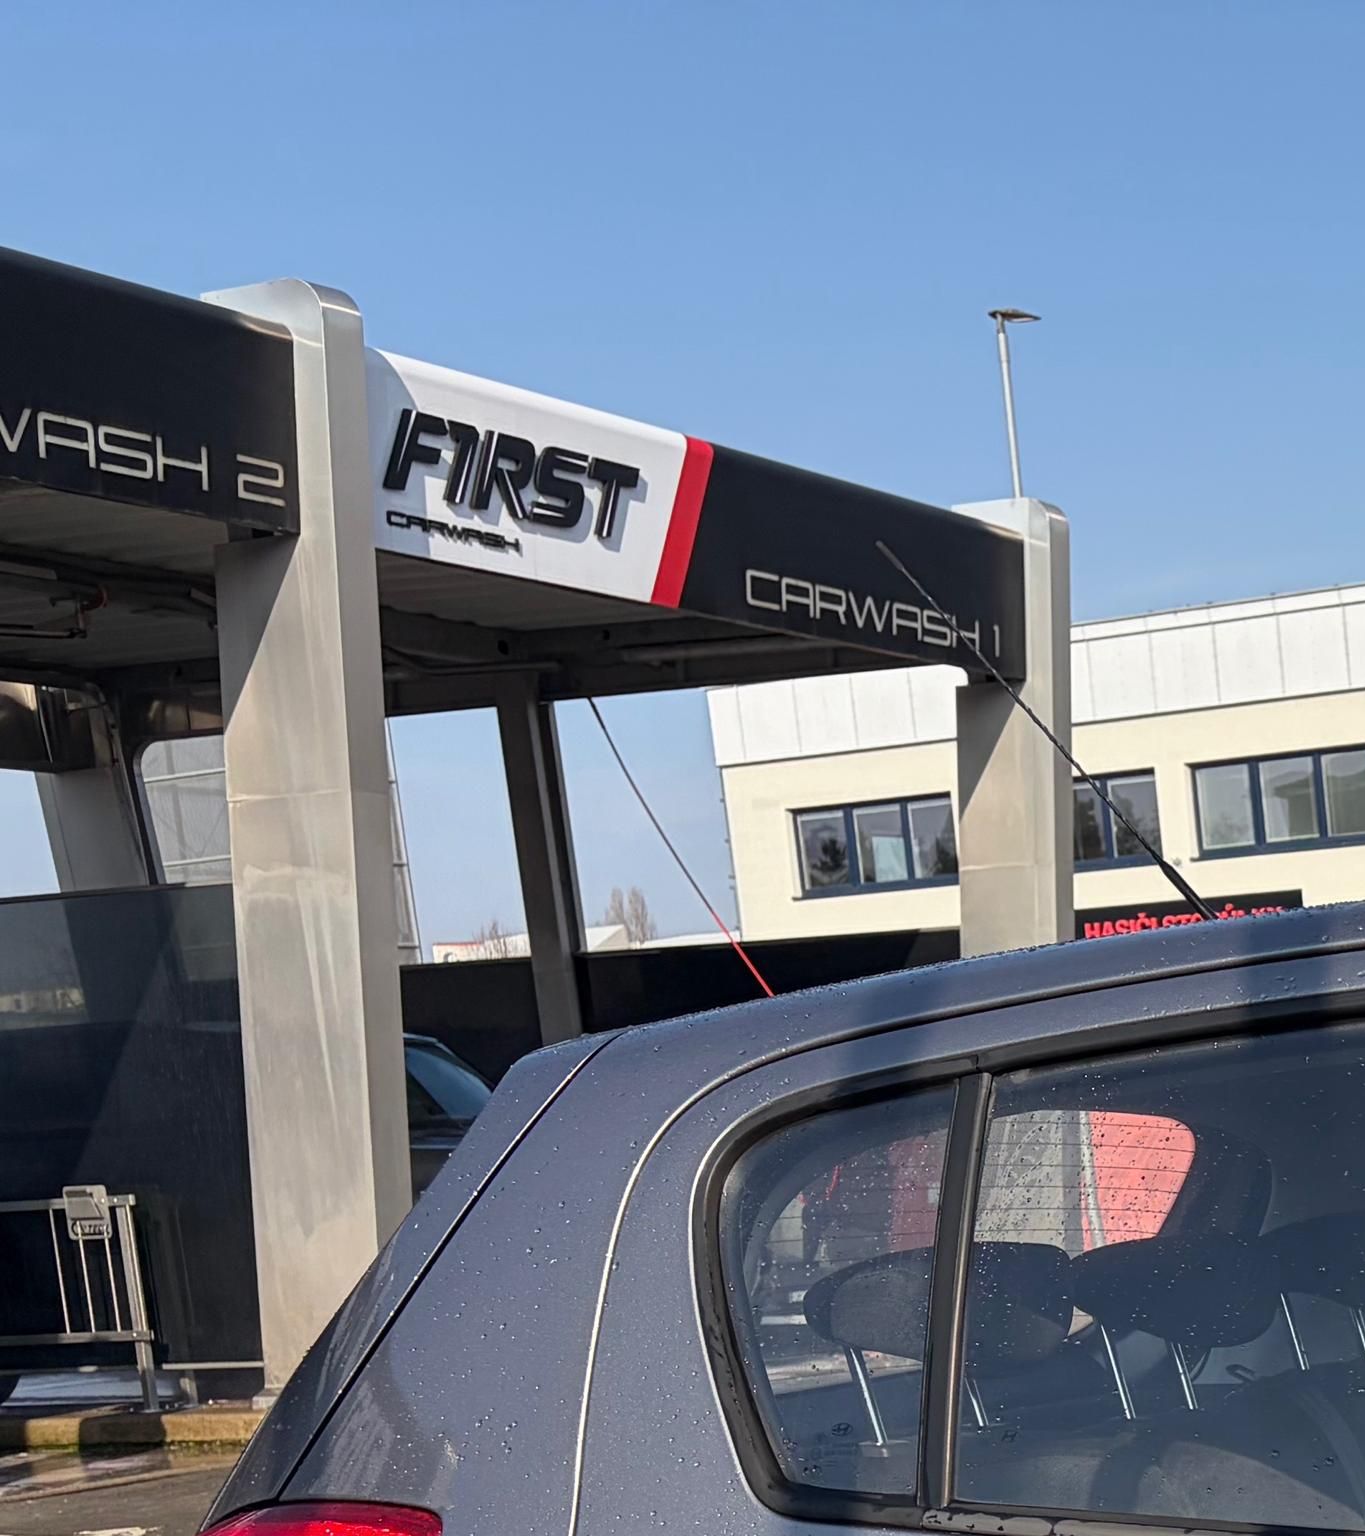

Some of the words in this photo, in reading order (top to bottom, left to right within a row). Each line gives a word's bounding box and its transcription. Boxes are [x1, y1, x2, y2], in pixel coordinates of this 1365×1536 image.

[236, 454, 286, 507] 2
[386, 511, 521, 553] CARWASH
[745, 569, 981, 651] CARWASH
[993, 624, 1000, 657] 1
